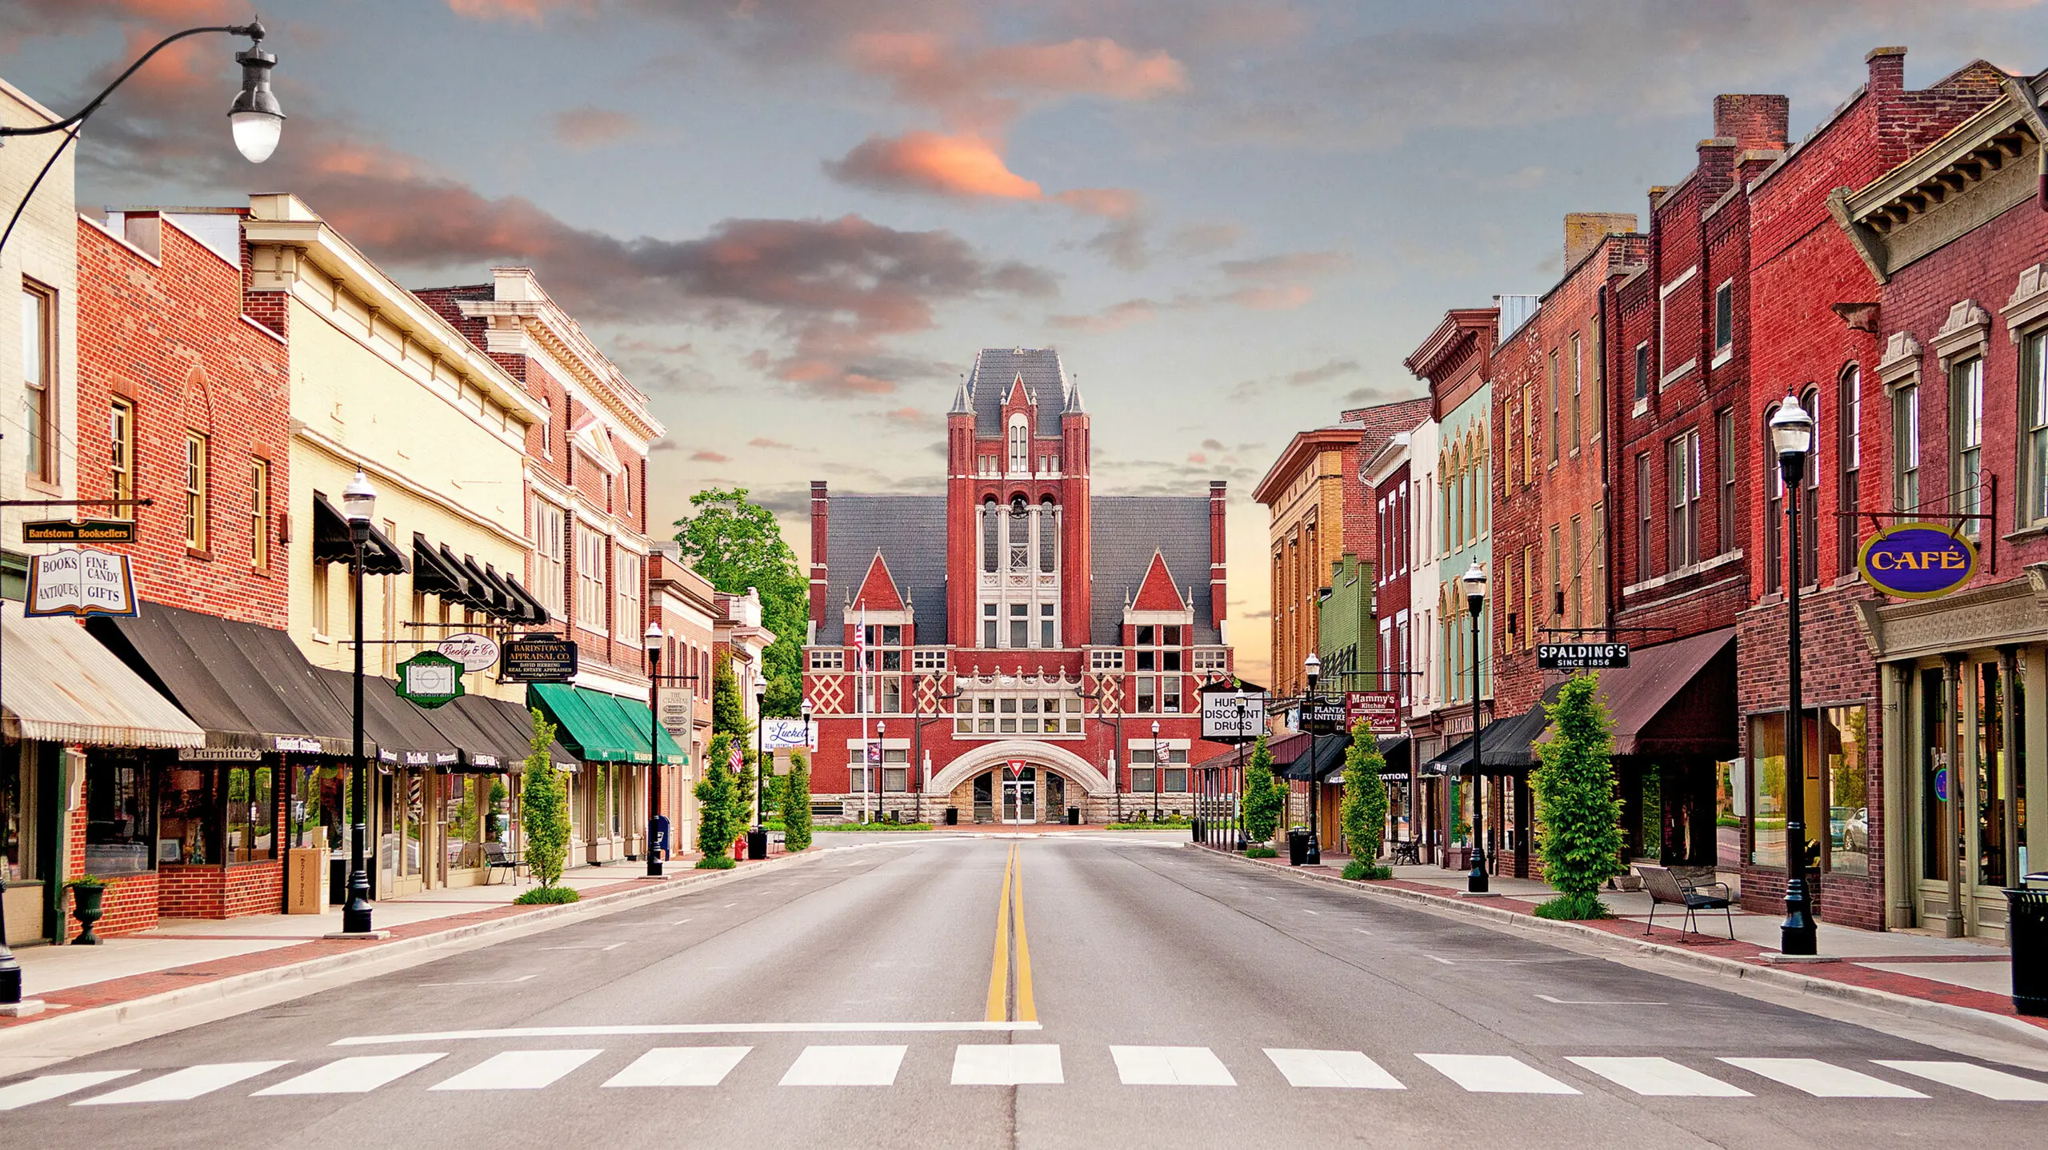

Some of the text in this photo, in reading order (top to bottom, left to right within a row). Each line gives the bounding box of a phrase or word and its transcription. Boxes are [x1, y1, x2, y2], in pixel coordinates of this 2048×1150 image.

[29, 529, 128, 538] Bardstown Booksellers
[86, 557, 109, 570] FINE
[1871, 545, 1965, 570] CAFÉ
[43, 557, 77, 573] BOOKS
[87, 568, 119, 583] CANDY
[39, 583, 79, 599] ANTIQUES
[87, 586, 119, 602] GIFTS
[514, 644, 566, 652] BARDSTOWN
[1540, 646, 1626, 658] SPALDING'S
[1214, 698, 1249, 707] HURT
[1351, 694, 1395, 704] Mammy's
[1214, 721, 1252, 730] DRUGS
[193, 748, 257, 759] Furniture
